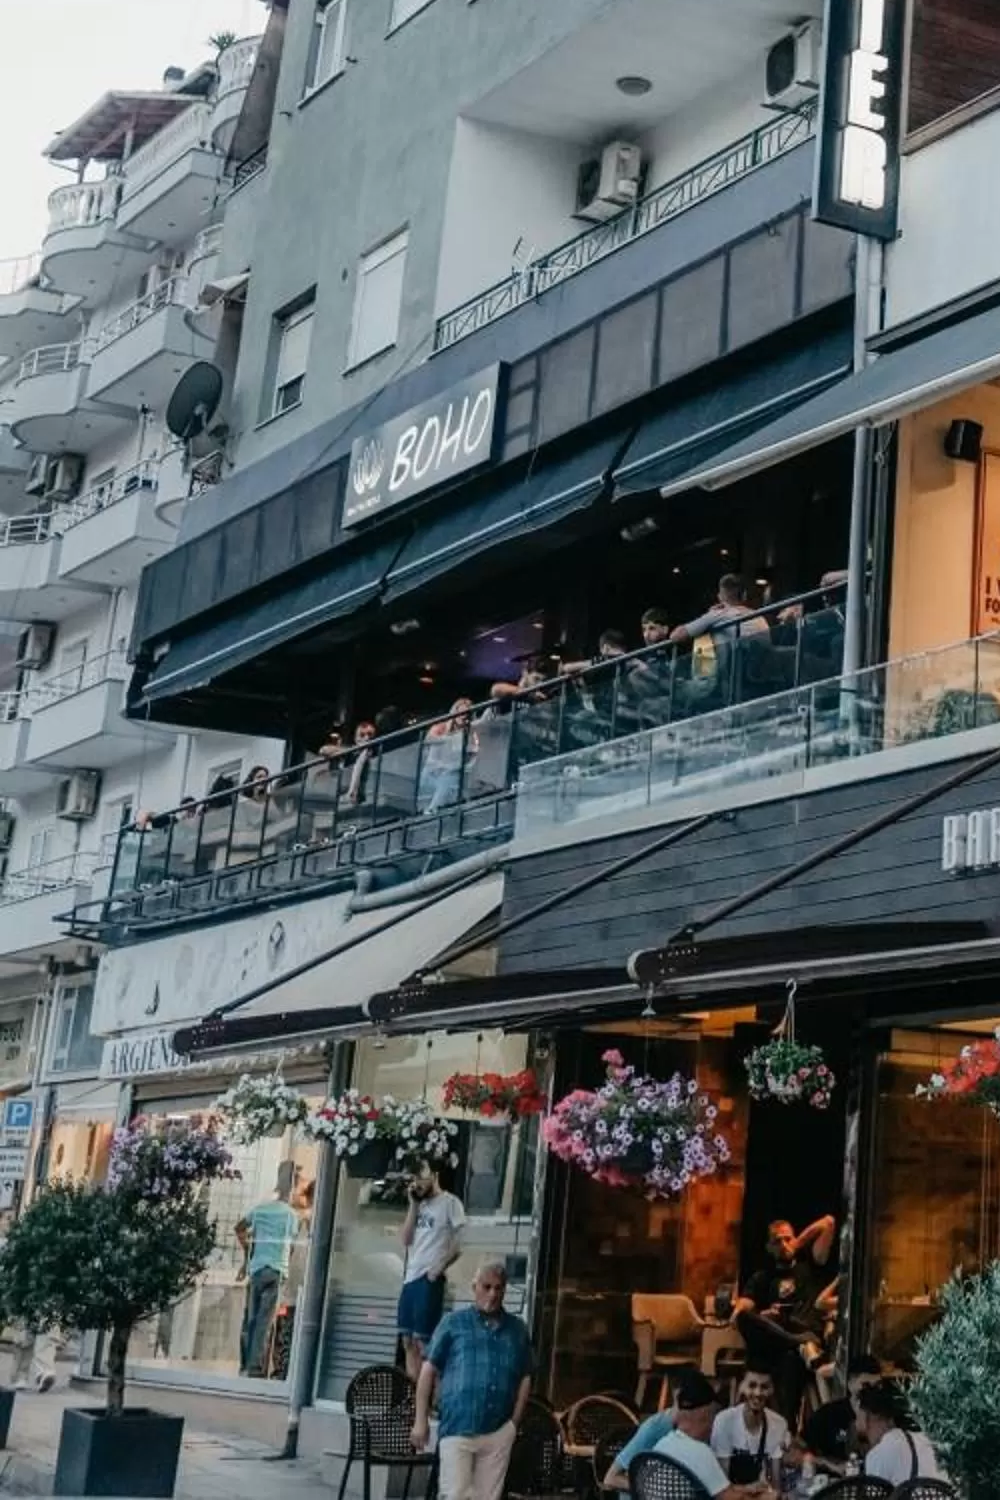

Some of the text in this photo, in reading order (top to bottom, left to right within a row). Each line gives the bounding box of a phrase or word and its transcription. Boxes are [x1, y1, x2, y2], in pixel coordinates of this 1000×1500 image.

[388, 388, 491, 490] BOHO
[985, 576, 991, 595] I
[11, 1103, 28, 1125] P
